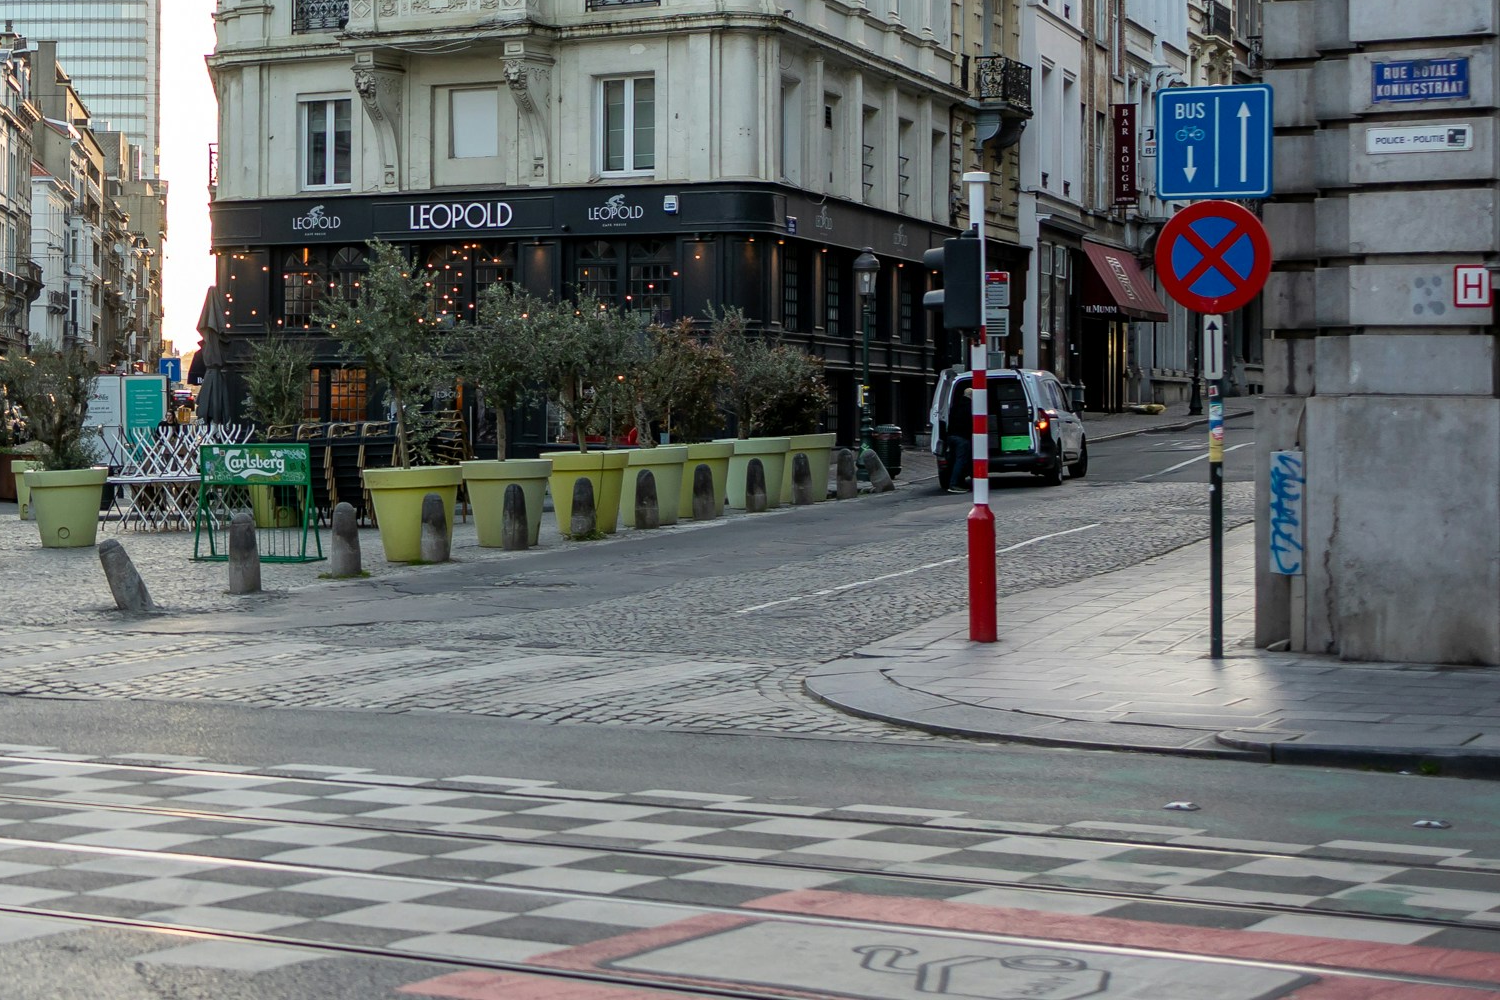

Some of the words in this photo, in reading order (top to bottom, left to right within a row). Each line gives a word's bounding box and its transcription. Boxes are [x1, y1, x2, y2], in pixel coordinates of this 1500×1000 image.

[1383, 67, 1407, 80] RUE
[1376, 81, 1465, 97] KONINGSTRAAT
[1175, 103, 1206, 120] BUS
[1121, 108, 1129, 135] BAR
[1375, 136, 1405, 145] POLICE
[1413, 134, 1445, 144] POLITIE
[1121, 146, 1130, 192] ROUGE
[410, 202, 513, 230] LEOPOLD
[588, 205, 644, 221] LEOPOLD
[292, 216, 341, 230] LEOPOLD
[1463, 273, 1483, 299] H
[224, 449, 285, 474] Carlsberg
